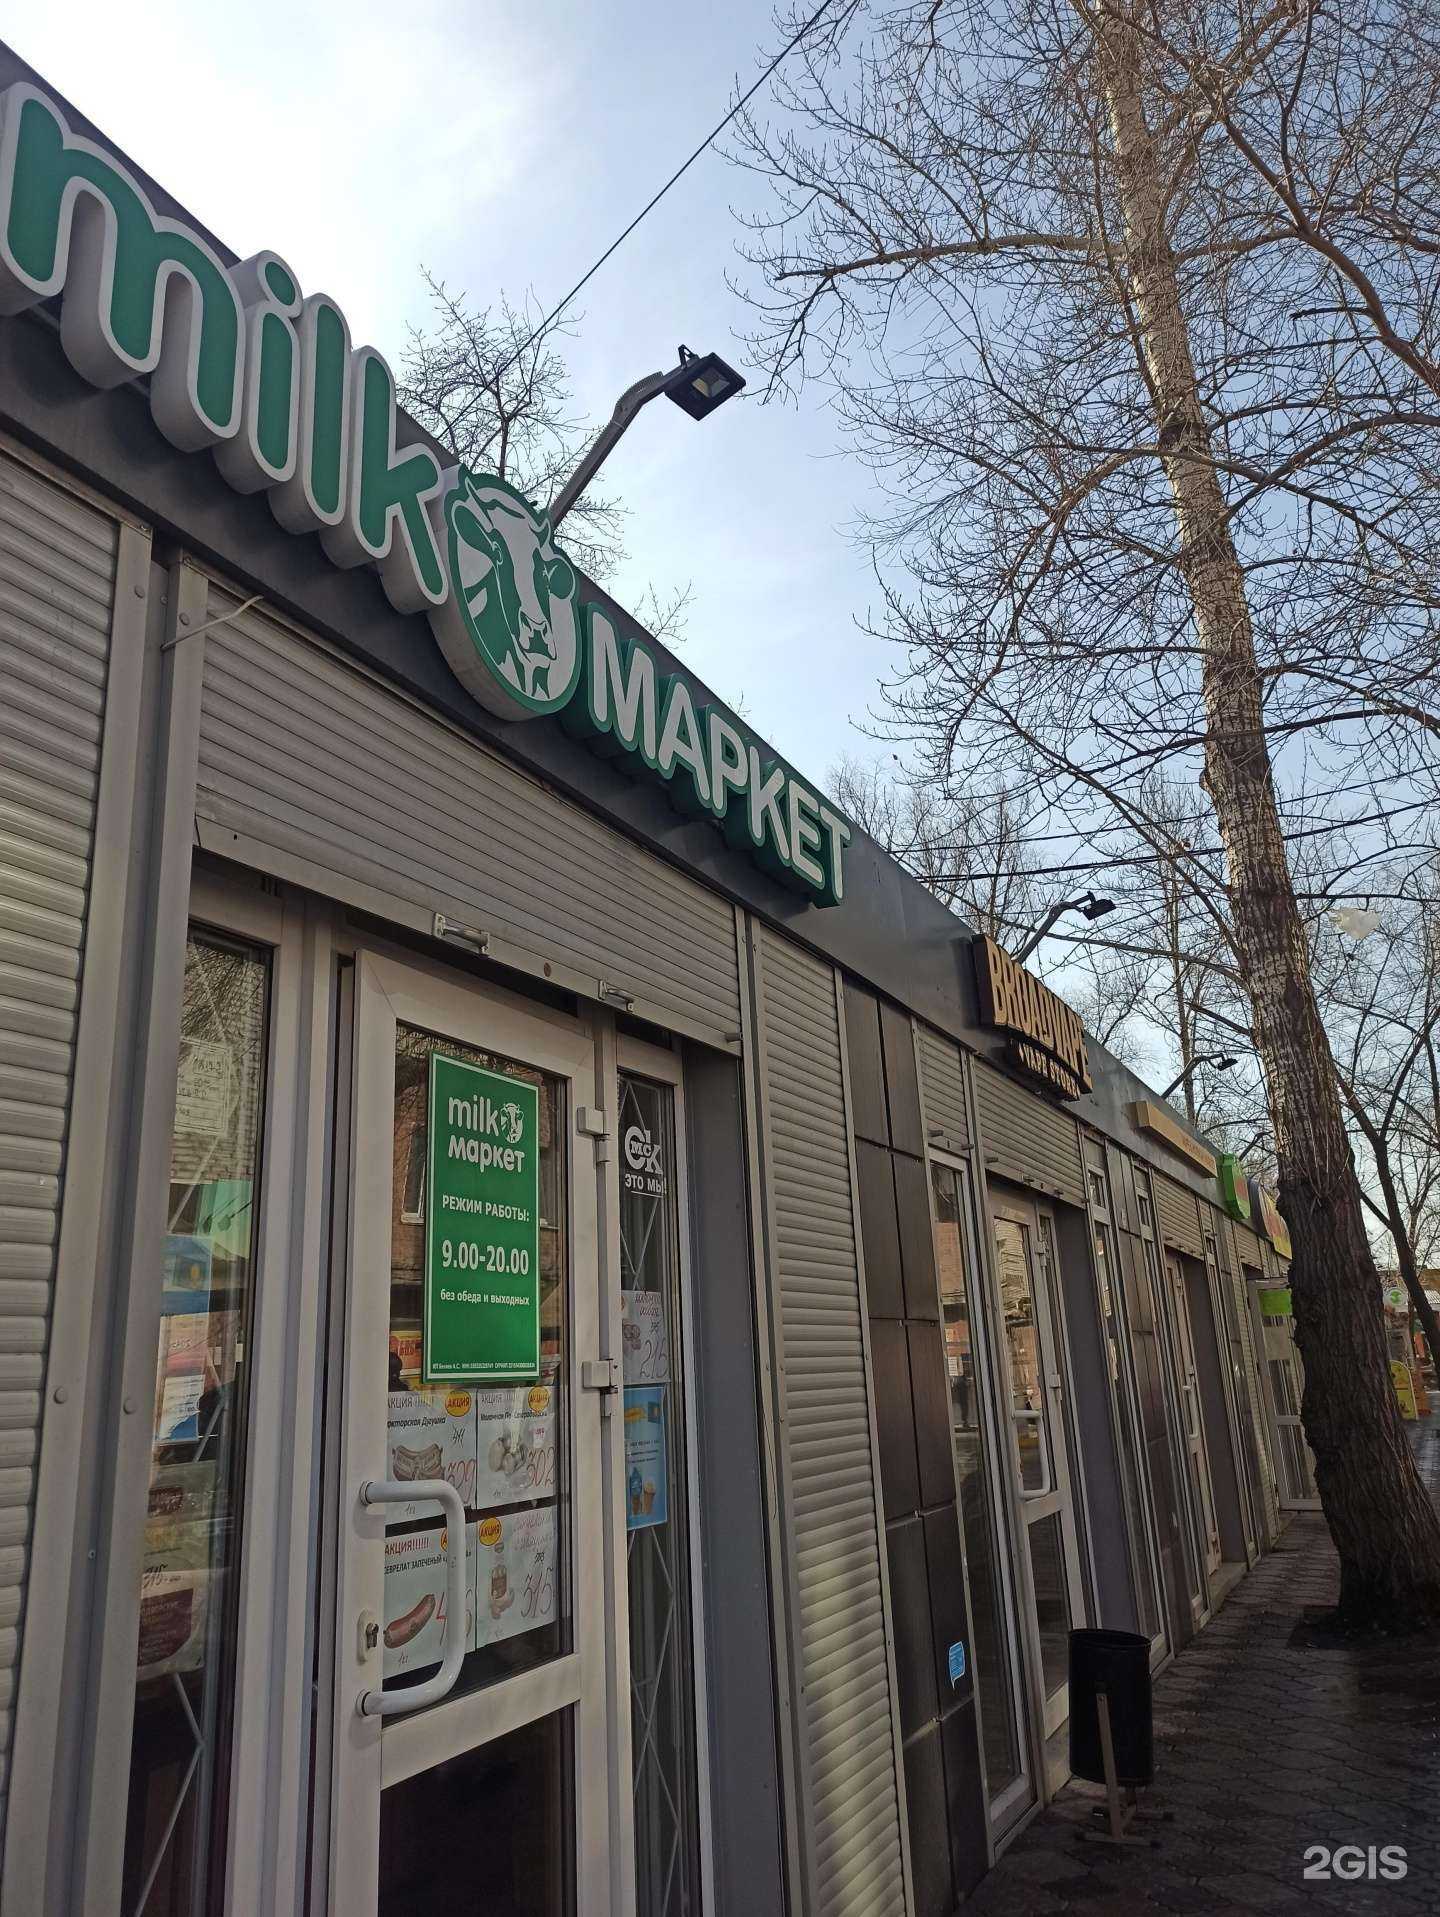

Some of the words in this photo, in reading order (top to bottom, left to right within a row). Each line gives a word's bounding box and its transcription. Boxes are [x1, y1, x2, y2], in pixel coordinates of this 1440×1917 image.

[3, 90, 447, 604] milk
[592, 604, 850, 901] МАРКЕТ
[448, 1094, 499, 1136] milk
[625, 1173, 644, 1190] ЭТО
[442, 1194, 482, 1214] РЕЖИМ
[485, 1202, 530, 1222] РАБОТЫ:
[442, 1239, 529, 1276] 9.00-20.00
[440, 1289, 455, 1301] без
[457, 1290, 481, 1304] обеда
[483, 1294, 489, 1302] и
[490, 1295, 530, 1306] выходных
[447, 1396, 470, 1408] АКЦИЯ
